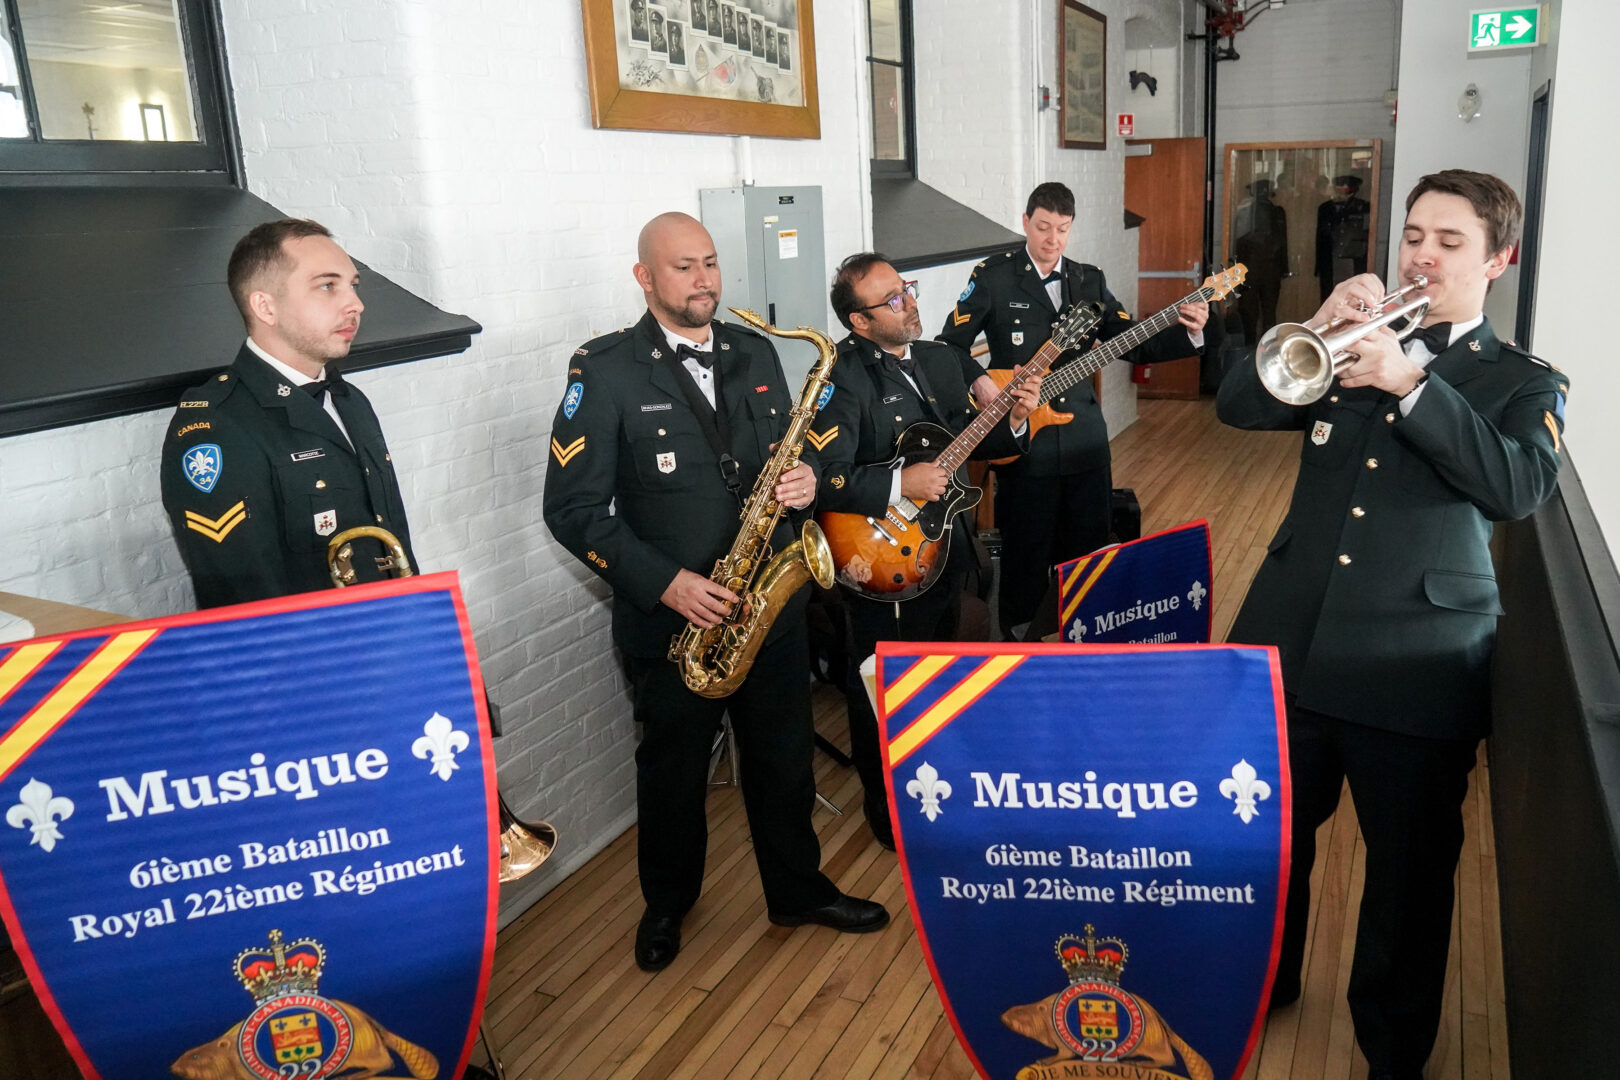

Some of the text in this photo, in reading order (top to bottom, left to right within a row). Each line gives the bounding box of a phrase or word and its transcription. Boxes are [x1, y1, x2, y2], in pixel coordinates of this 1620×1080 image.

[177, 422, 211, 437] CANADA
[199, 476, 212, 485] 34
[1094, 595, 1180, 635] Musique
[98, 748, 389, 822] Musique
[970, 771, 1198, 818] Musique
[129, 827, 391, 889] 6ième Bataillon
[985, 844, 1193, 870] 6ième Bataillon
[68, 843, 466, 943] Royal 22ième Régiment
[940, 876, 1256, 906] Royal 22ième Régiment
[1082, 1037, 1119, 1062] 22
[279, 1058, 325, 1080] 22
[1042, 1068, 1060, 1080] JE
[1064, 1065, 1088, 1077] ME
